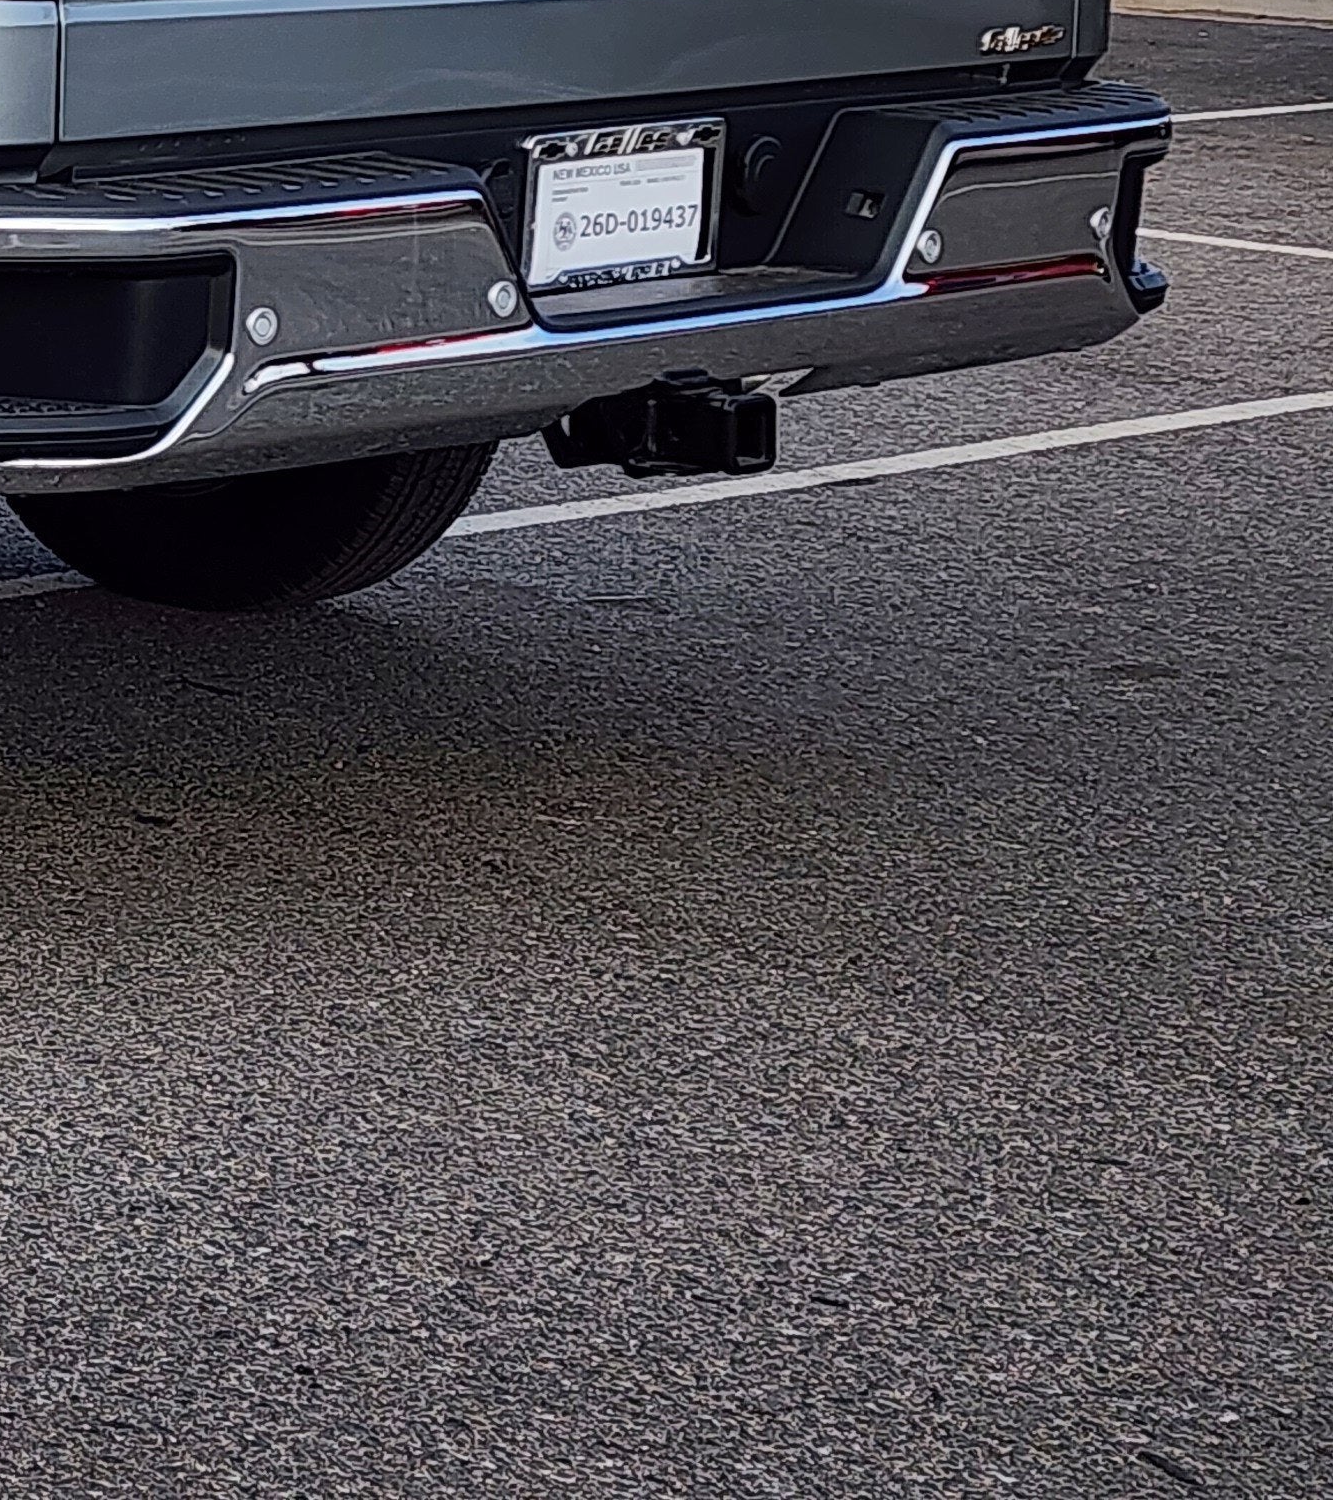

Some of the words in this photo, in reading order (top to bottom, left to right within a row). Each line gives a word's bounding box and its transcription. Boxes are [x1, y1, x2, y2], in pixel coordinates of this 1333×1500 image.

[552, 168, 574, 182] NEW
[575, 165, 612, 179] MEXICO
[612, 162, 631, 176] USA
[579, 204, 699, 238] 26D-019437
